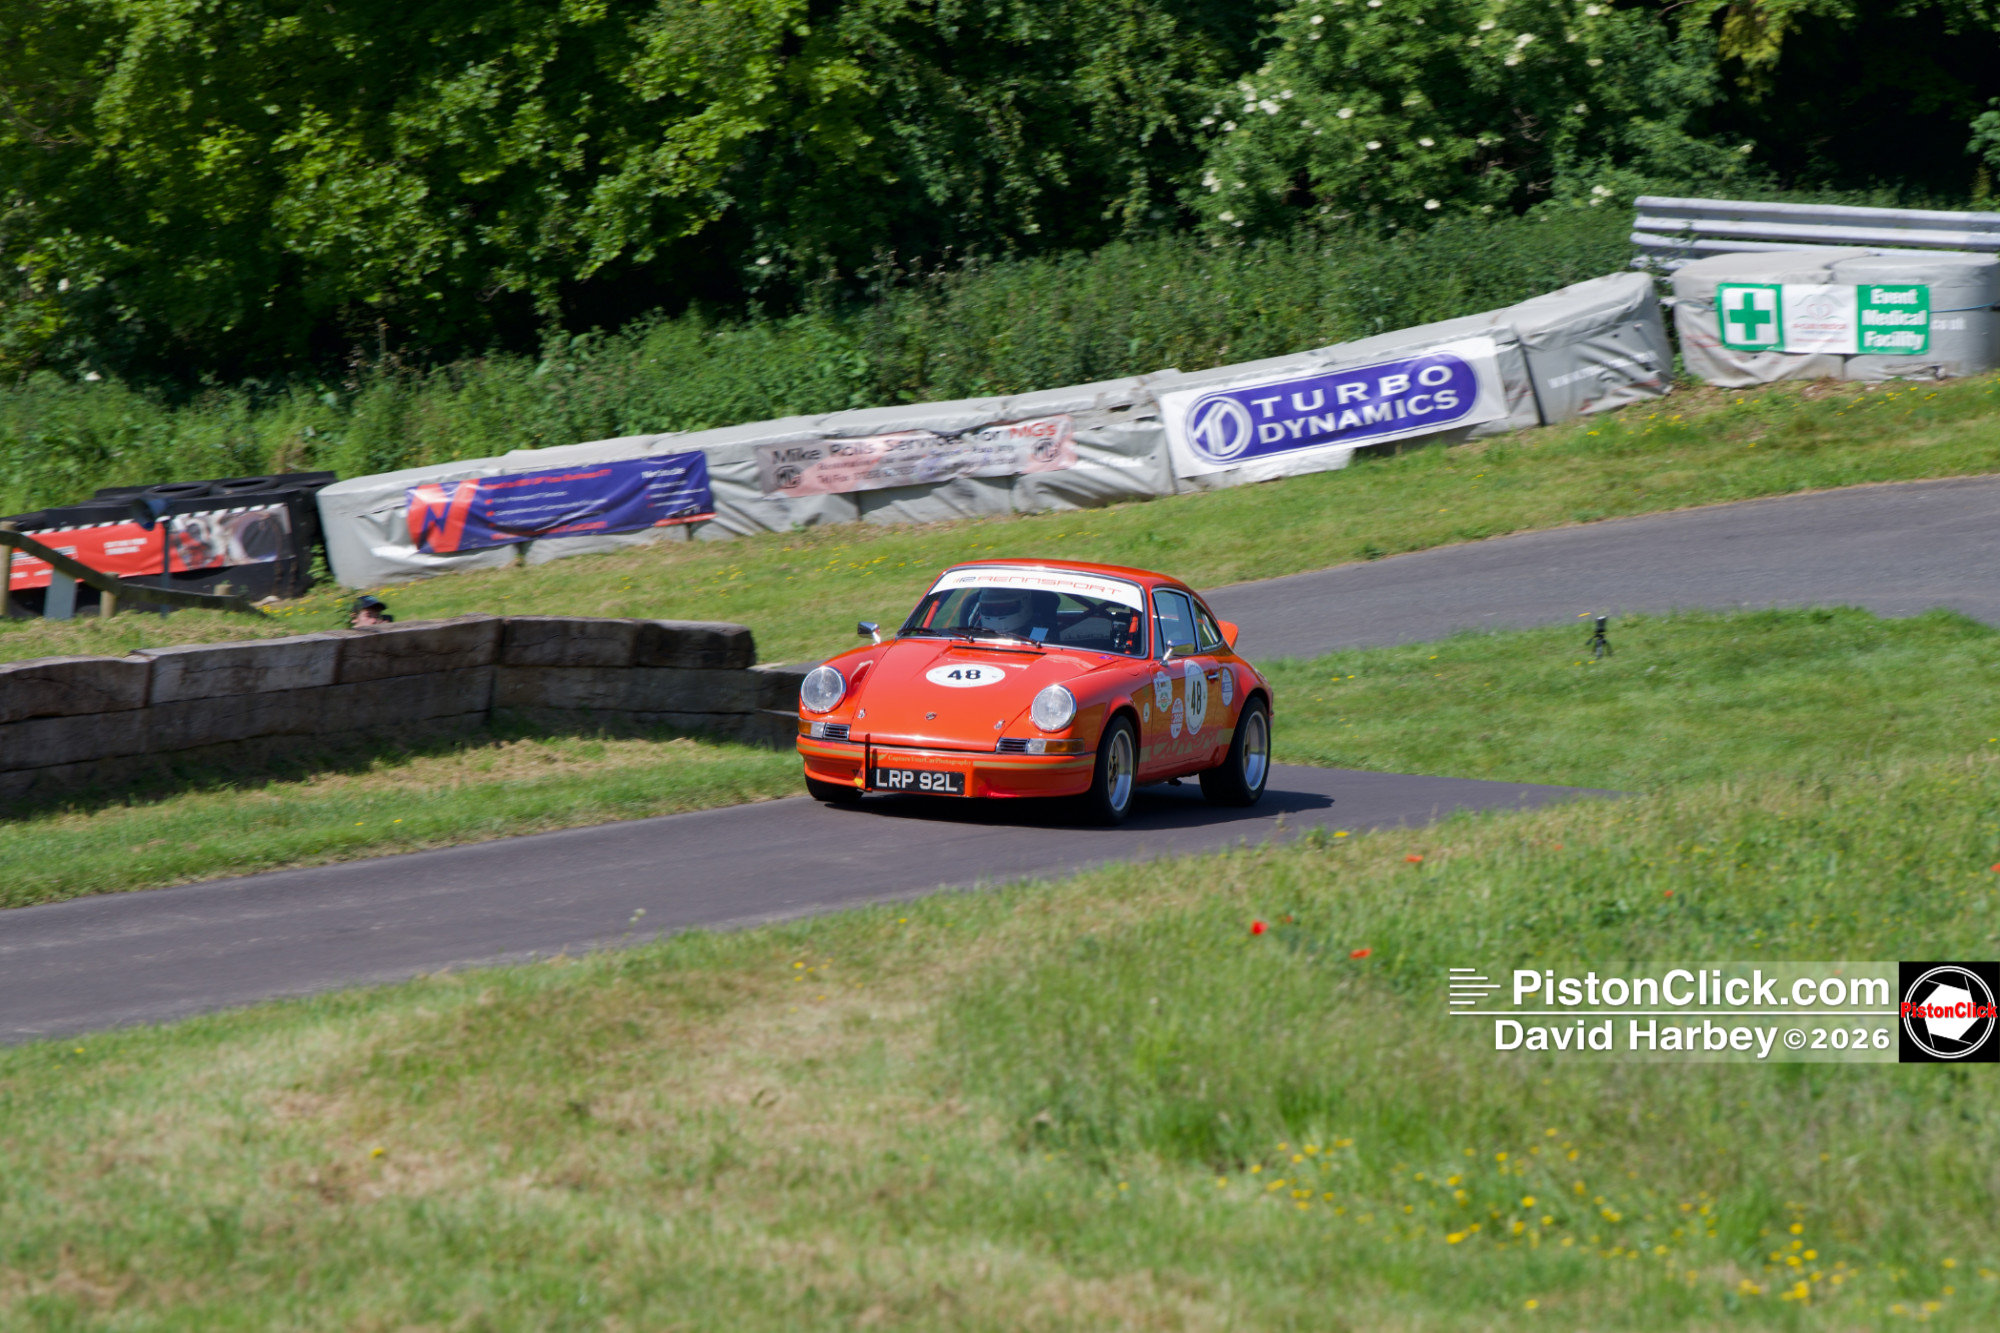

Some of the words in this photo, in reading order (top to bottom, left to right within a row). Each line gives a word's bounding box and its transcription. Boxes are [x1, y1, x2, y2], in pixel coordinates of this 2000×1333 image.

[1870, 289, 1918, 304] Event
[1861, 310, 1927, 325] Medical
[1864, 331, 1925, 350] Facility
[1251, 366, 1453, 418] TURBO
[1258, 389, 1460, 444] DYNAMICS
[772, 447, 821, 464] Mike
[1009, 422, 1057, 439] MGs
[977, 576, 1122, 594] RENNSPORT
[947, 669, 982, 680] 48
[1191, 680, 1202, 716] 48
[876, 768, 914, 789] LRP
[919, 772, 958, 792] 92L
